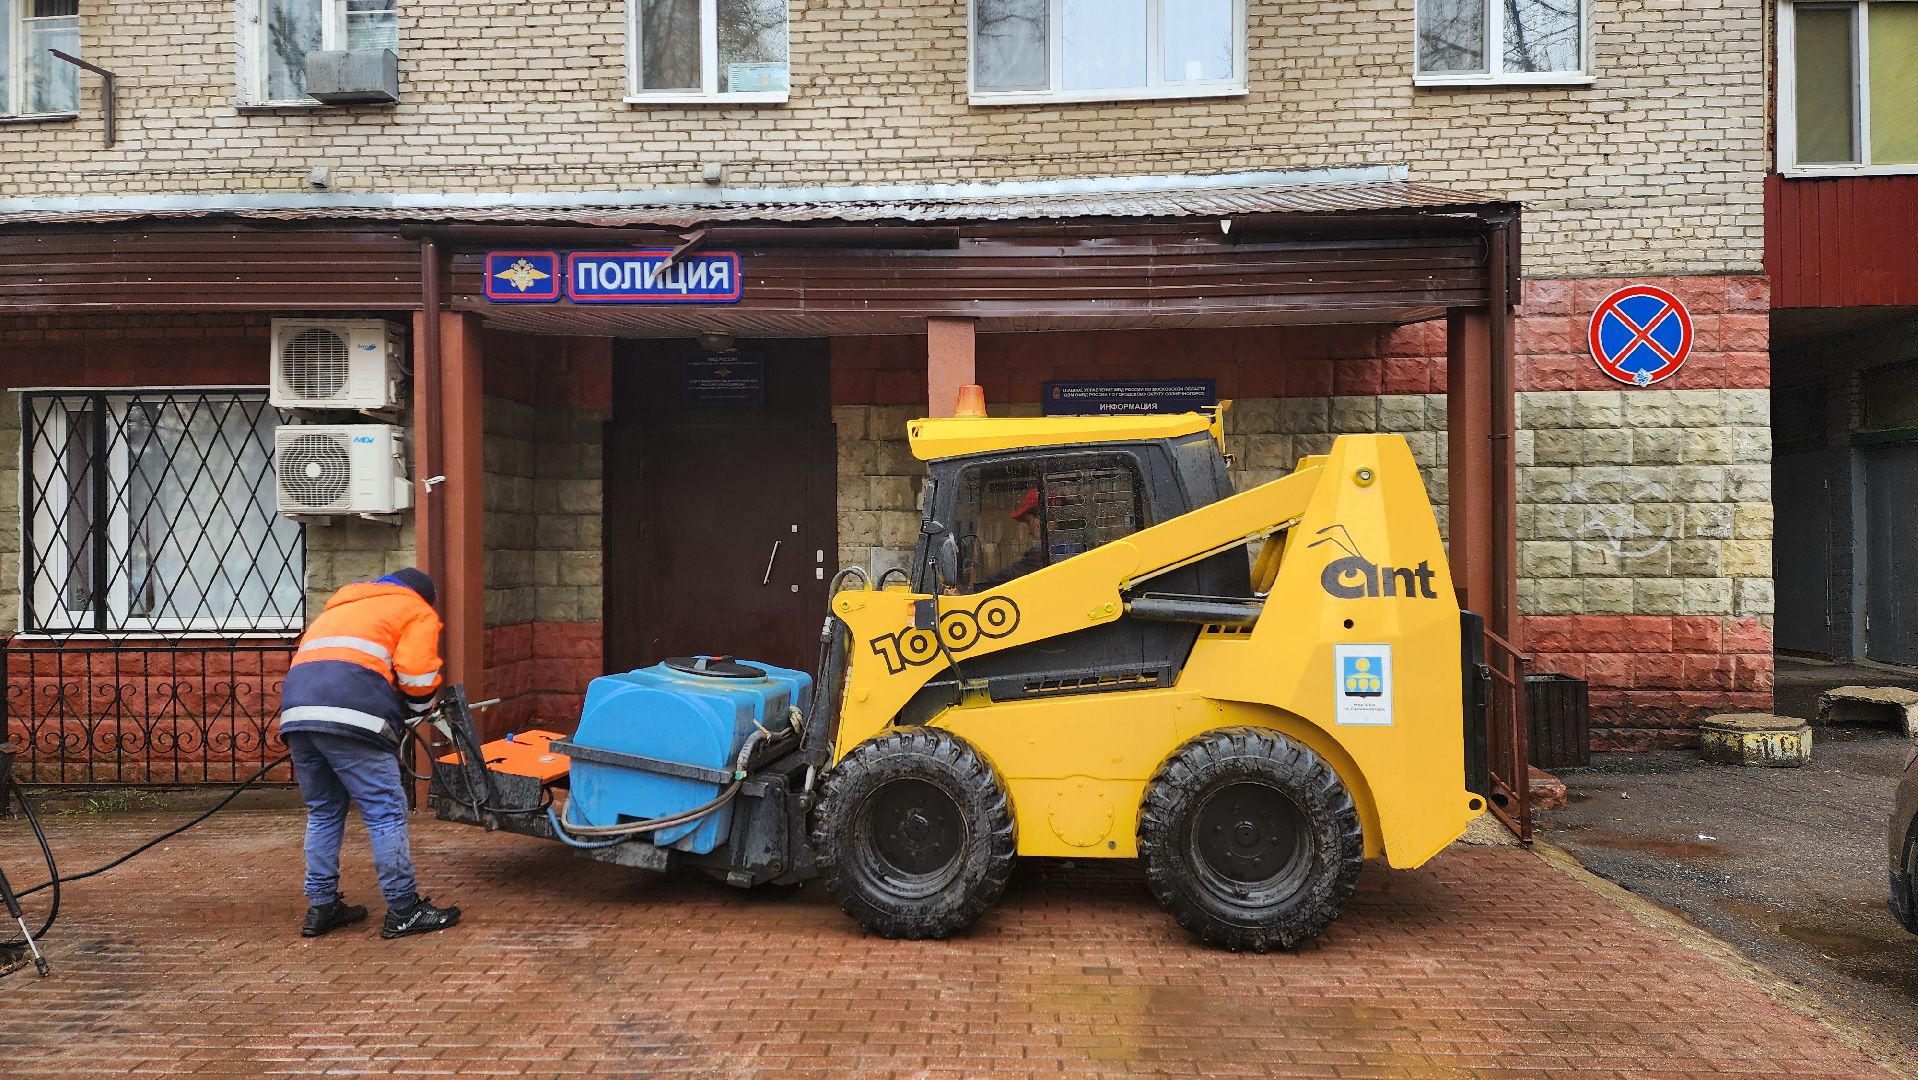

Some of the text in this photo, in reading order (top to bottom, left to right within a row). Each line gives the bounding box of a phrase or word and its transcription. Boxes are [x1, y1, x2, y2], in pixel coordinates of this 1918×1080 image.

[578, 261, 729, 294] ПОЛИЦИЯ
[1099, 403, 1158, 411] ИНФОРМАЦИЯ
[1321, 555, 1438, 599] ant
[870, 596, 1021, 676] 1000
